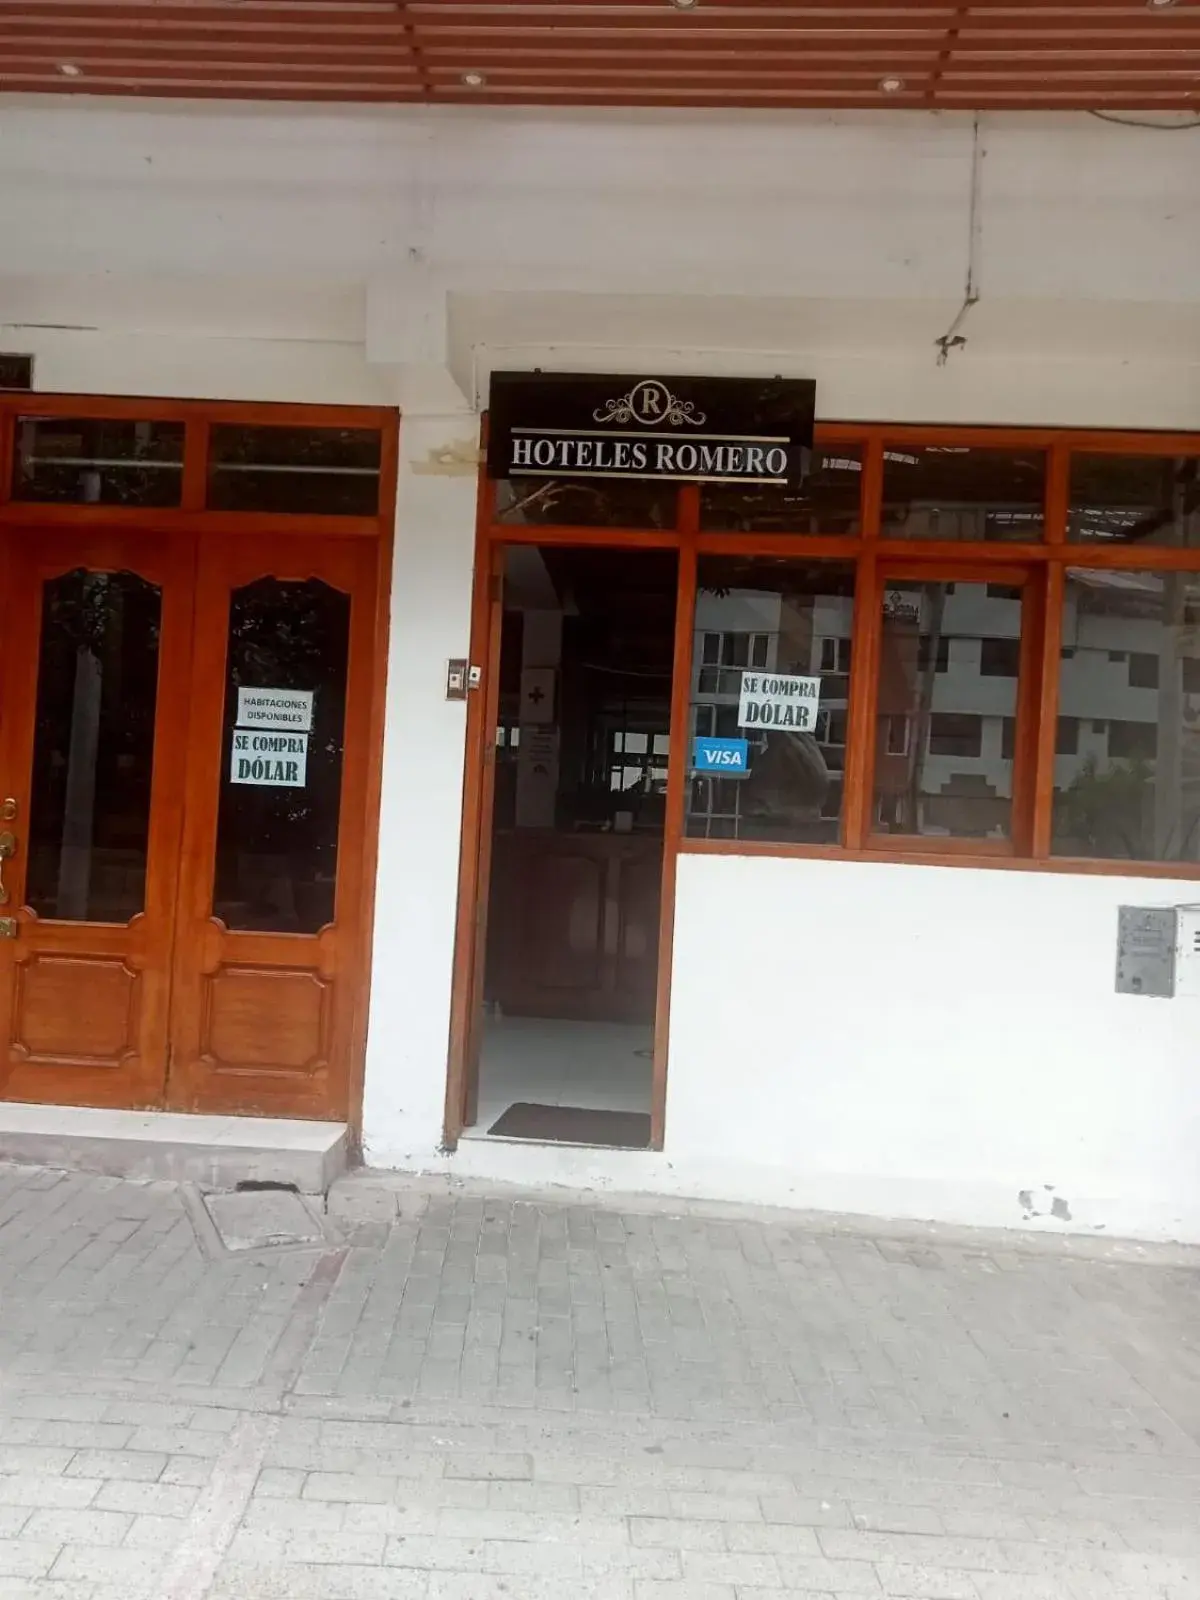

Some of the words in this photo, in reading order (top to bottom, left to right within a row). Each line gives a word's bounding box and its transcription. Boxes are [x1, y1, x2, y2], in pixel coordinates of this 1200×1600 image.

[640, 388, 661, 414] R
[511, 438, 647, 470] HOTELES
[656, 444, 788, 474] ROMERO
[743, 677, 758, 693] SE
[761, 678, 816, 698] COMPRA
[244, 697, 307, 709] HABITACIONES
[745, 699, 810, 727] DÓLAR
[247, 711, 302, 722] DISPONIBLES
[235, 735, 249, 751] SE
[252, 736, 304, 753] COMPRA
[703, 749, 742, 765] VISA
[238, 756, 298, 782] DÓLAR
